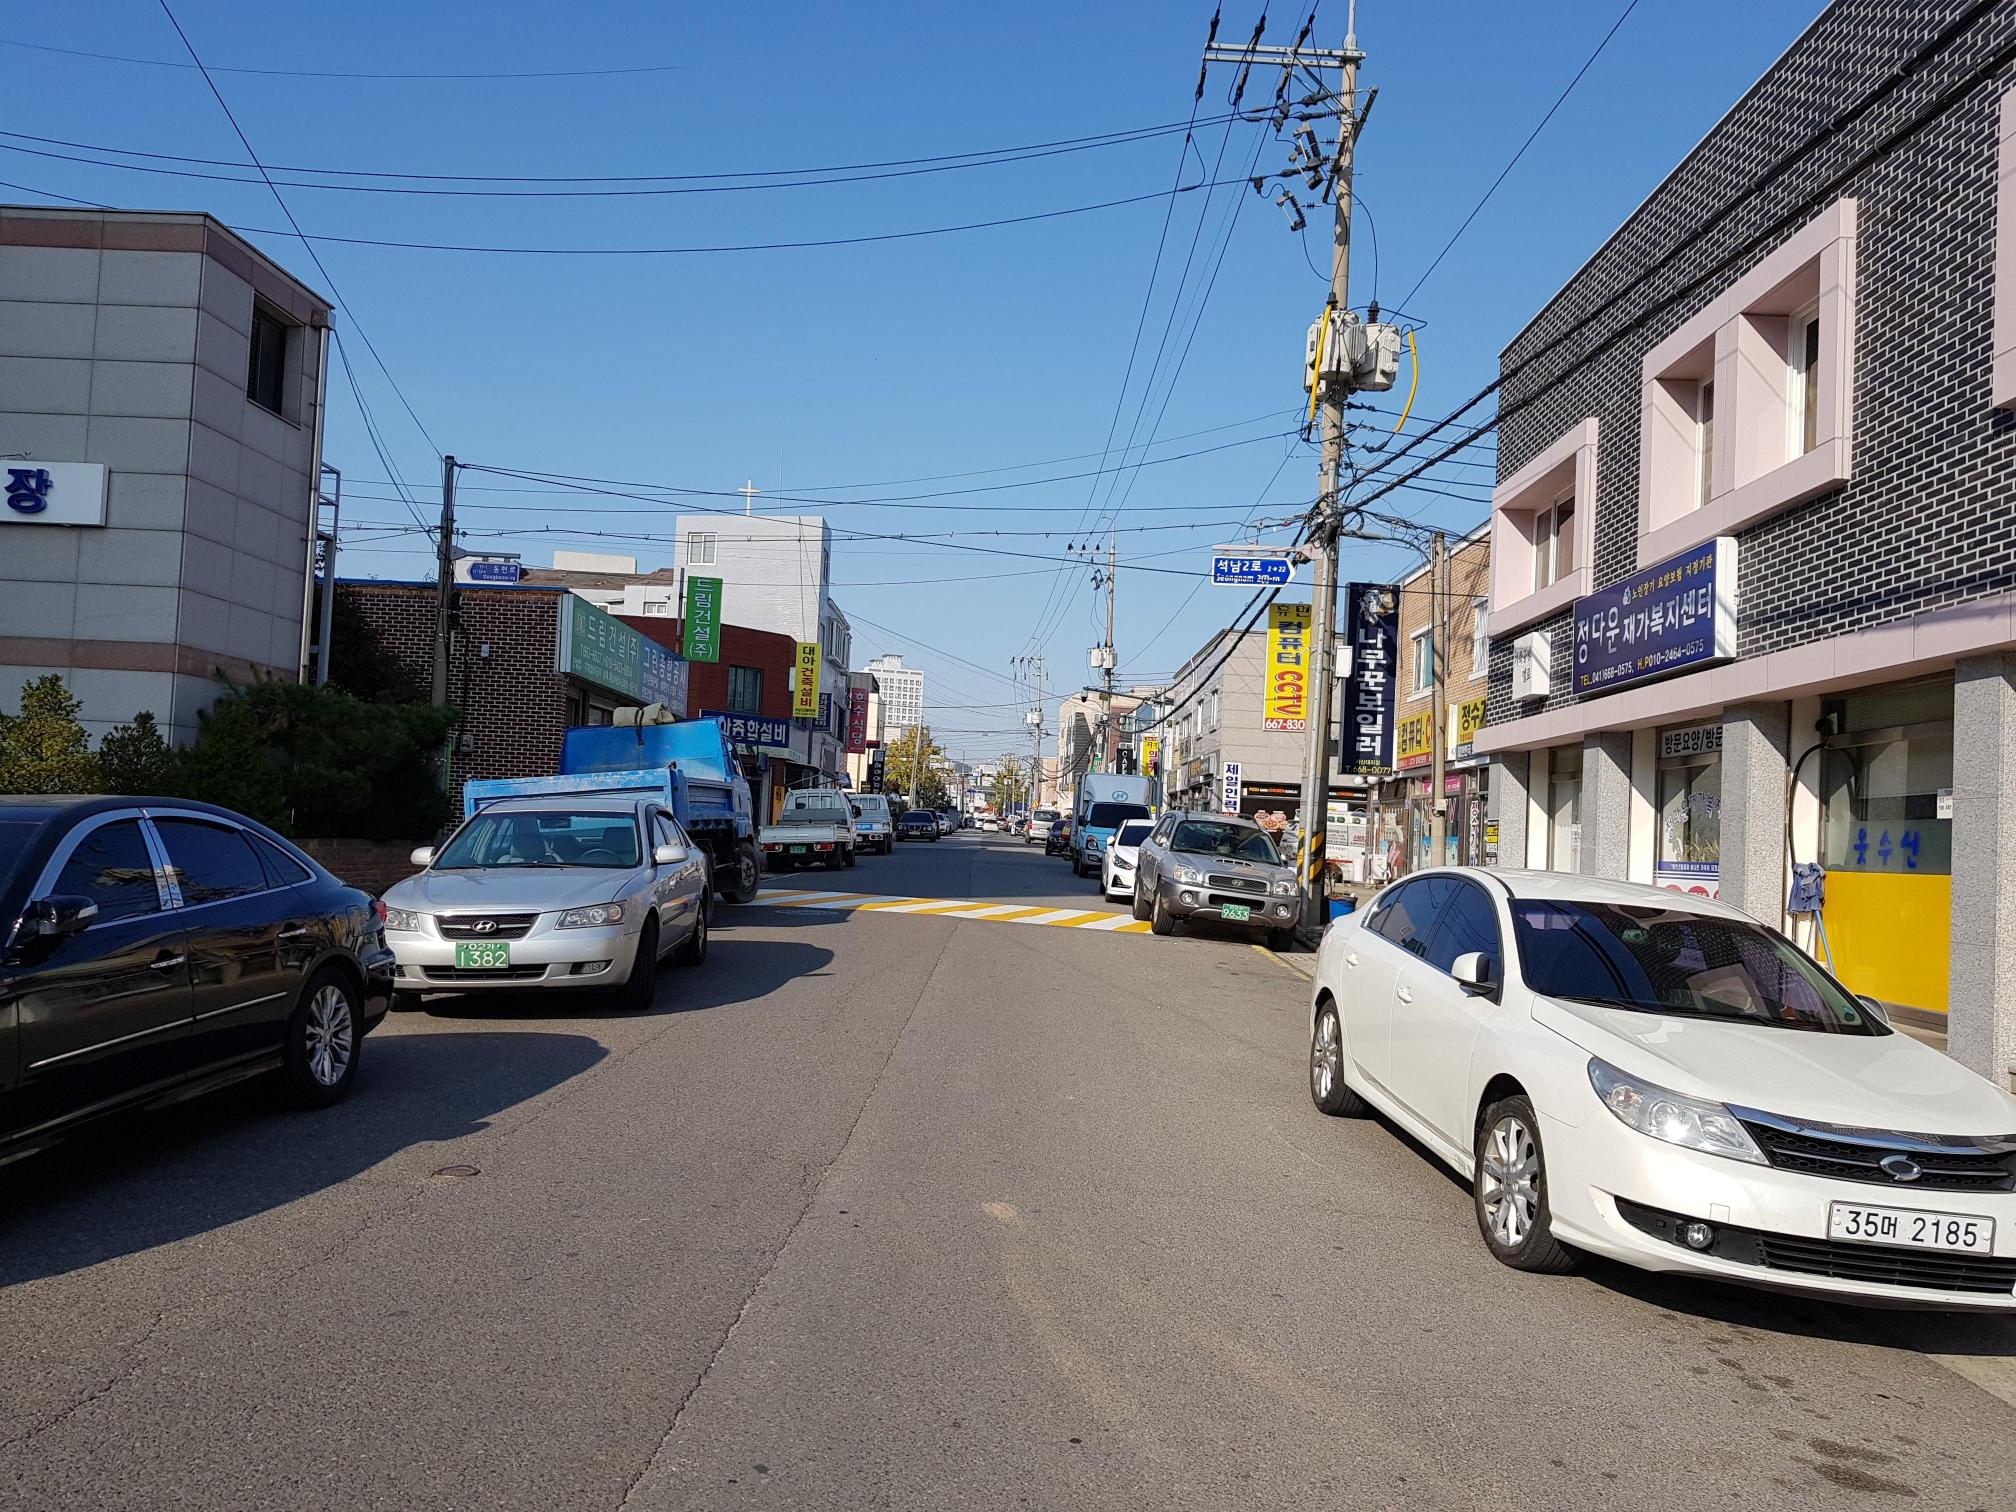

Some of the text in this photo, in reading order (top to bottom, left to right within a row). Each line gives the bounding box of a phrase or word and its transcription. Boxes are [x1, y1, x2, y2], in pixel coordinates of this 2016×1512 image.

[4, 468, 54, 514] 장
[1217, 560, 1262, 573] 석남2로
[1631, 553, 1713, 599] 노인장기 요양보험 지정기관
[587, 615, 639, 663] 드림건설(주)
[689, 577, 714, 659] 드림건설(주)
[1577, 582, 1712, 664] 정다운 재가복지센터
[802, 645, 815, 666] 대아
[1274, 621, 1304, 716] 컴퓨터 CCTV
[1355, 627, 1387, 757] 나무꾼보일러
[1225, 763, 1238, 811] 제일인력
[1223, 908, 1248, 919] 9633
[461, 951, 507, 967] 1382
[1911, 1217, 1978, 1247] 2185
